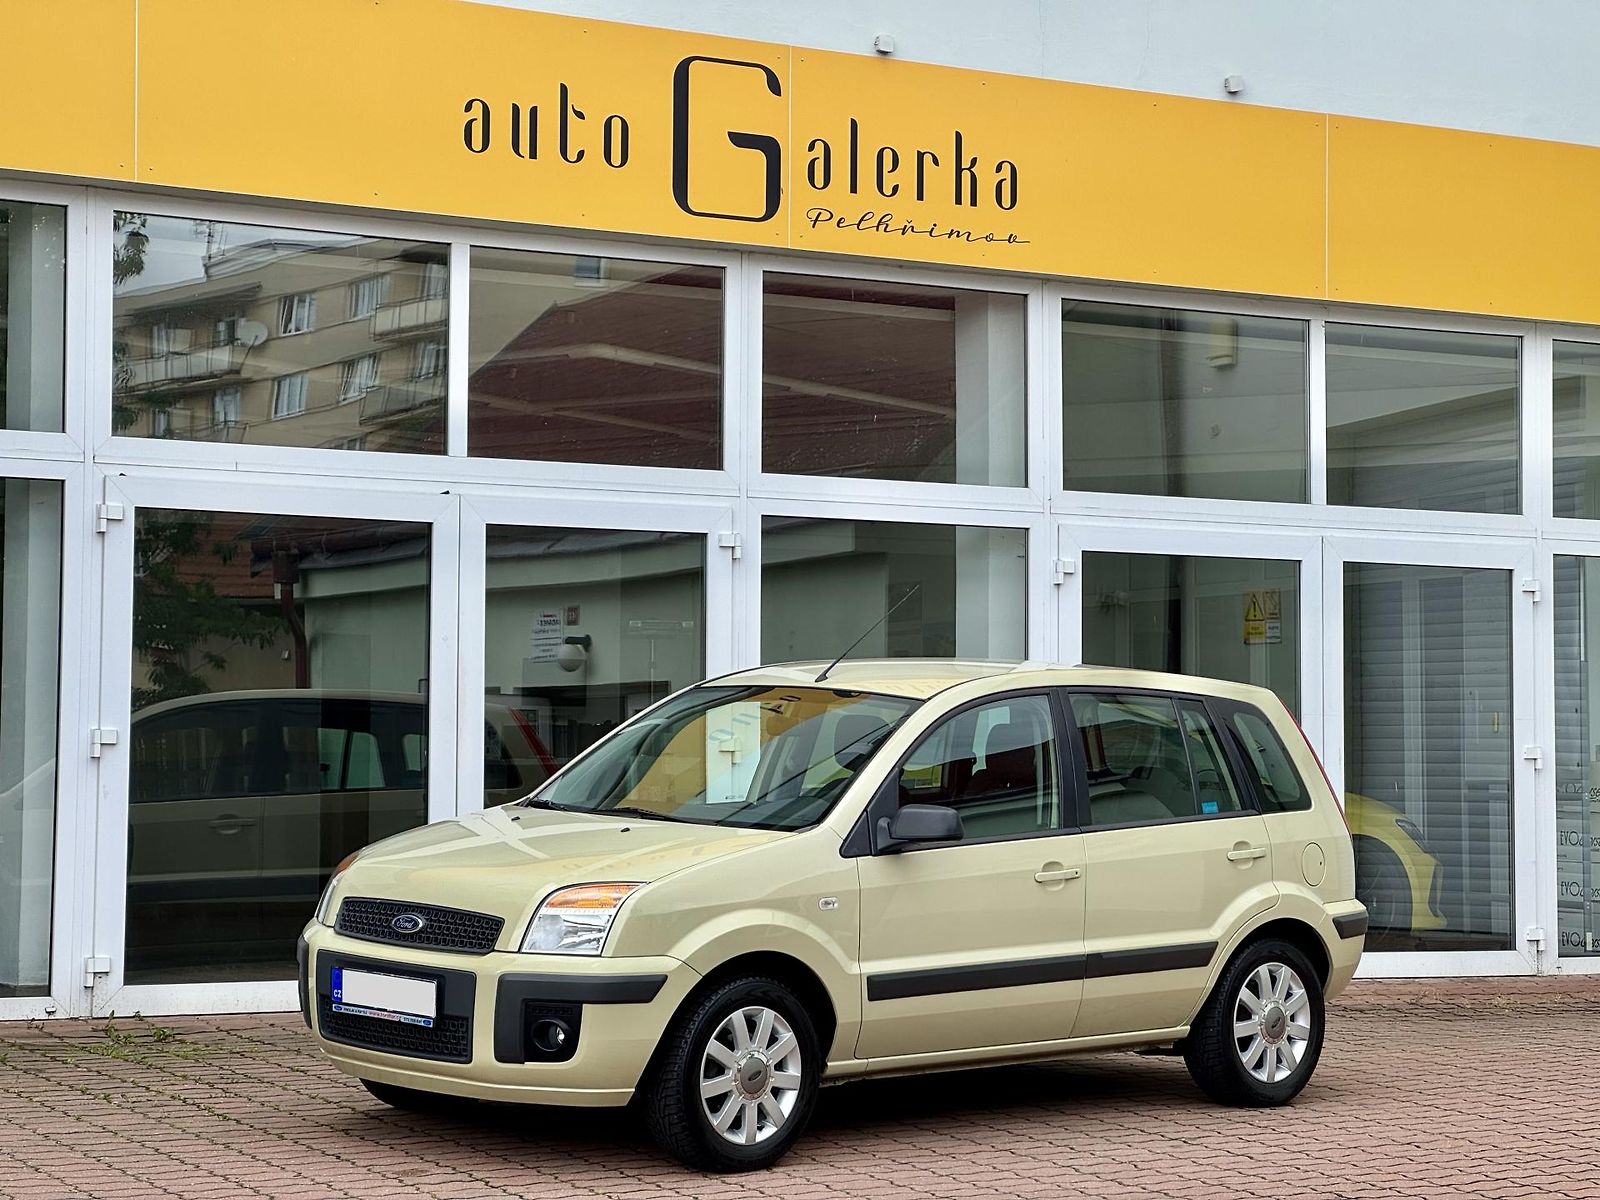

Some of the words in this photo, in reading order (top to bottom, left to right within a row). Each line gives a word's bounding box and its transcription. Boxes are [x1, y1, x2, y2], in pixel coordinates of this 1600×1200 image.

[463, 82, 629, 169] auto
[806, 207, 1030, 244] Pelhřimov
[333, 989, 342, 998] CZ
